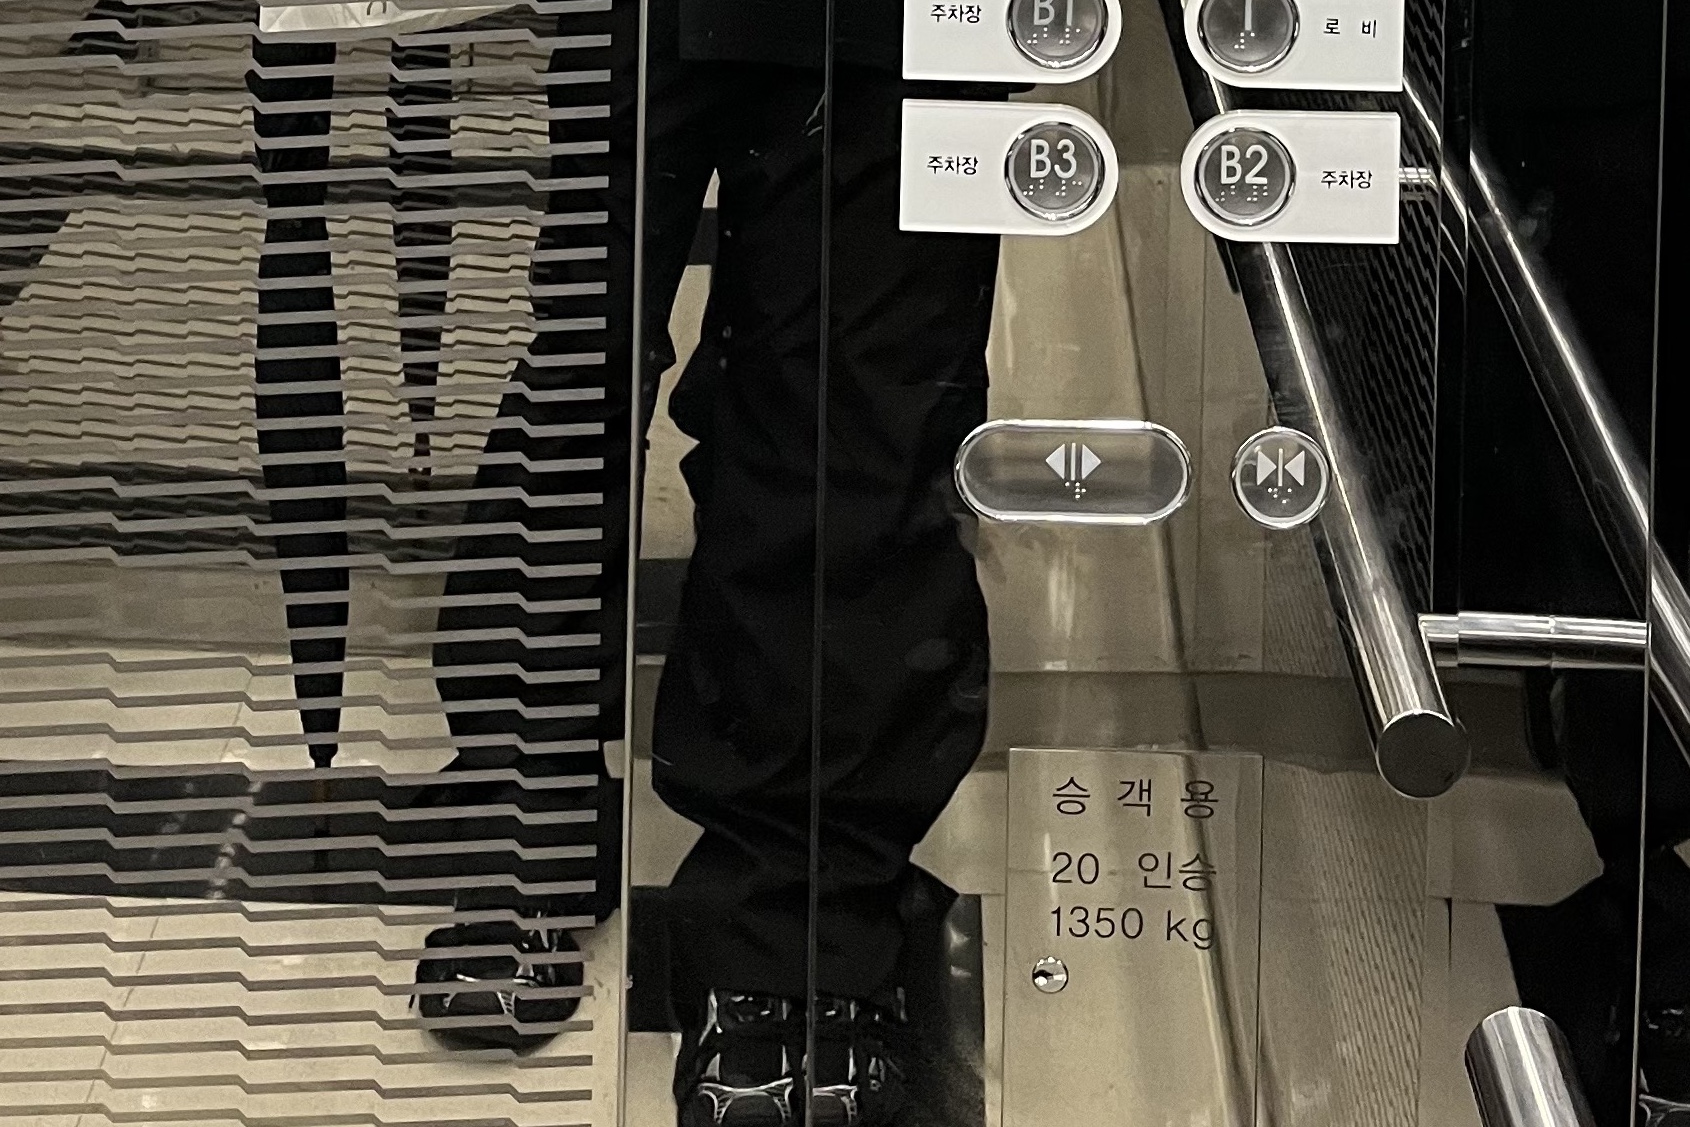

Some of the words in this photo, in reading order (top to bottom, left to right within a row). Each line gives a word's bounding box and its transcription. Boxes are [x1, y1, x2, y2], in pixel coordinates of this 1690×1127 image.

[930, 4, 982, 24] 주차장
[927, 156, 979, 176] 주차장
[1029, 139, 1078, 178] B3
[1220, 145, 1269, 185] B2
[1320, 170, 1373, 189] 주차장
[1052, 851, 1100, 884] 20
[1138, 851, 1217, 891] 인승
[1051, 905, 1144, 940] 1350
[1166, 909, 1215, 950] kg
